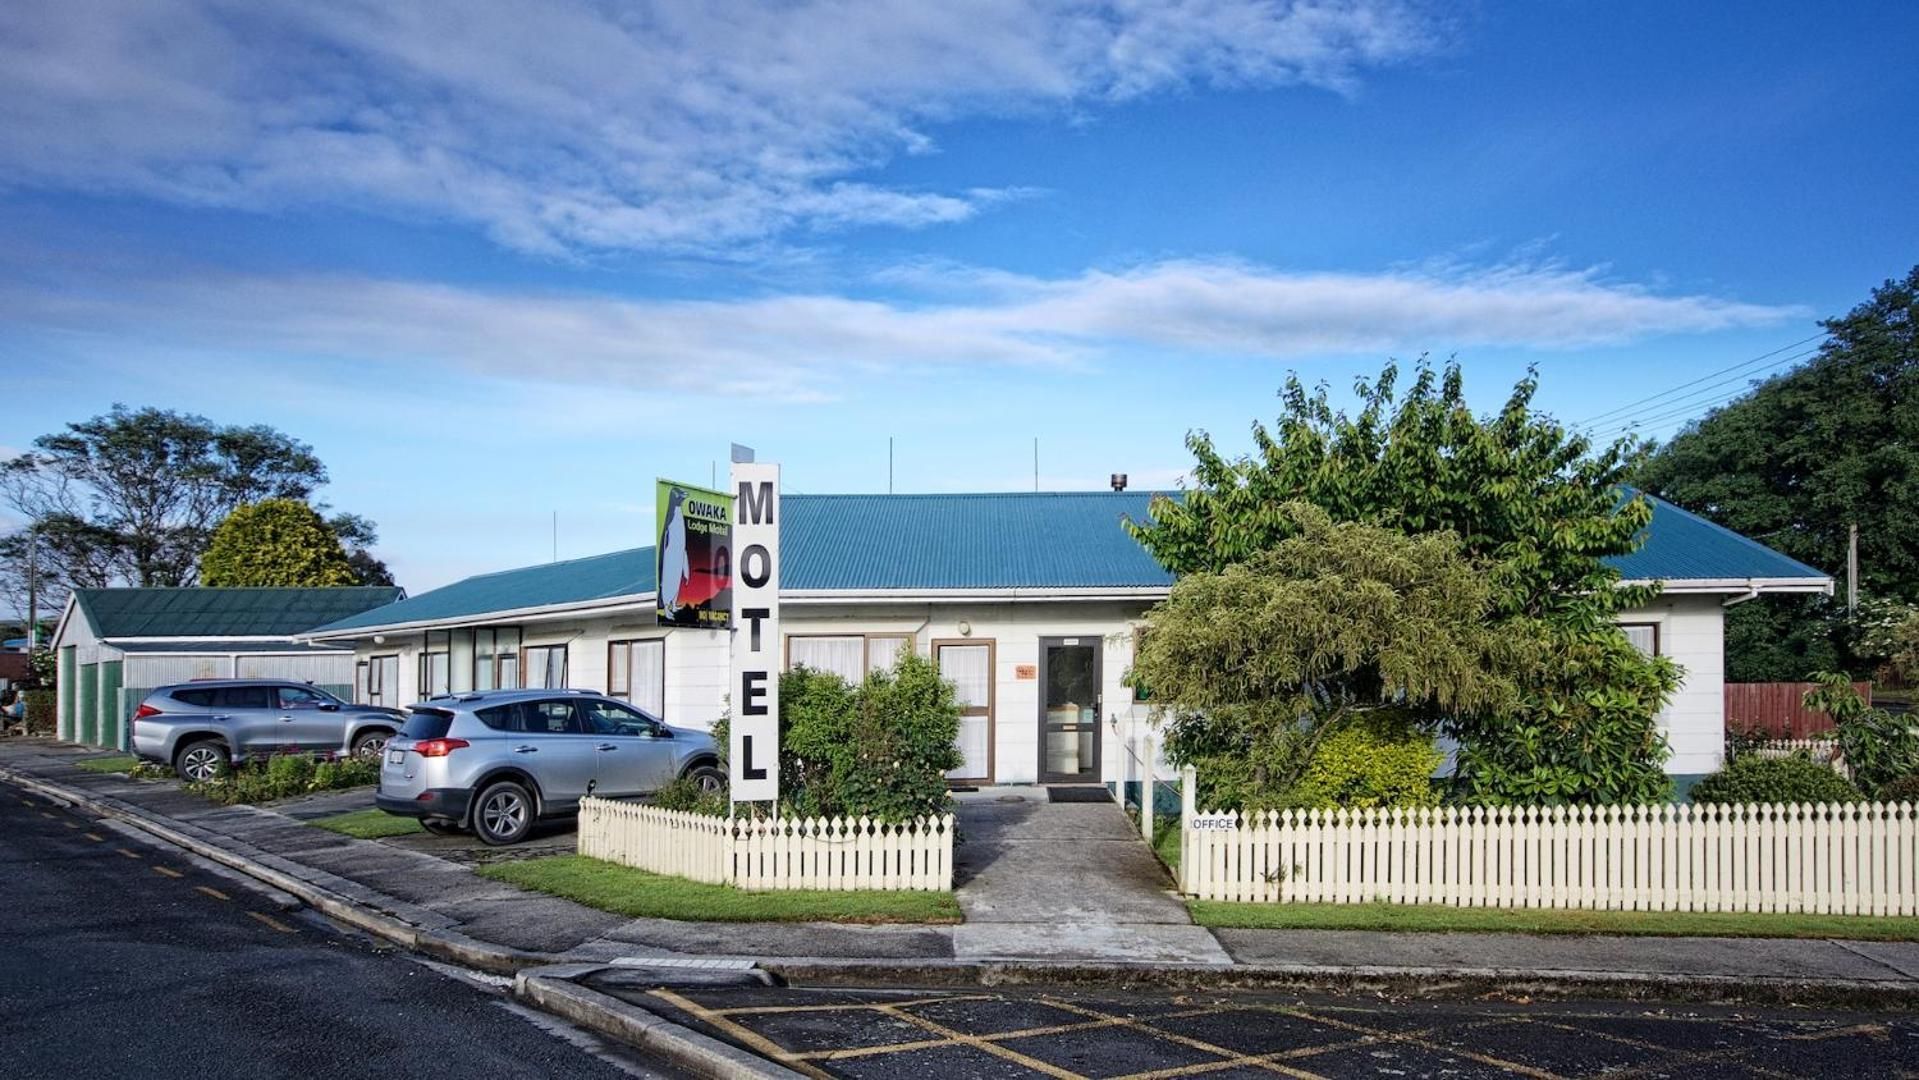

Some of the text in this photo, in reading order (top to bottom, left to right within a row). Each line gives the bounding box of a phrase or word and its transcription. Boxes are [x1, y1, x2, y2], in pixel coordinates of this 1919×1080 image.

[688, 500, 727, 521] OWAKA
[687, 519, 708, 535] Lodge
[738, 481, 774, 780] MOTEL
[1193, 818, 1233, 829] OFFICE
